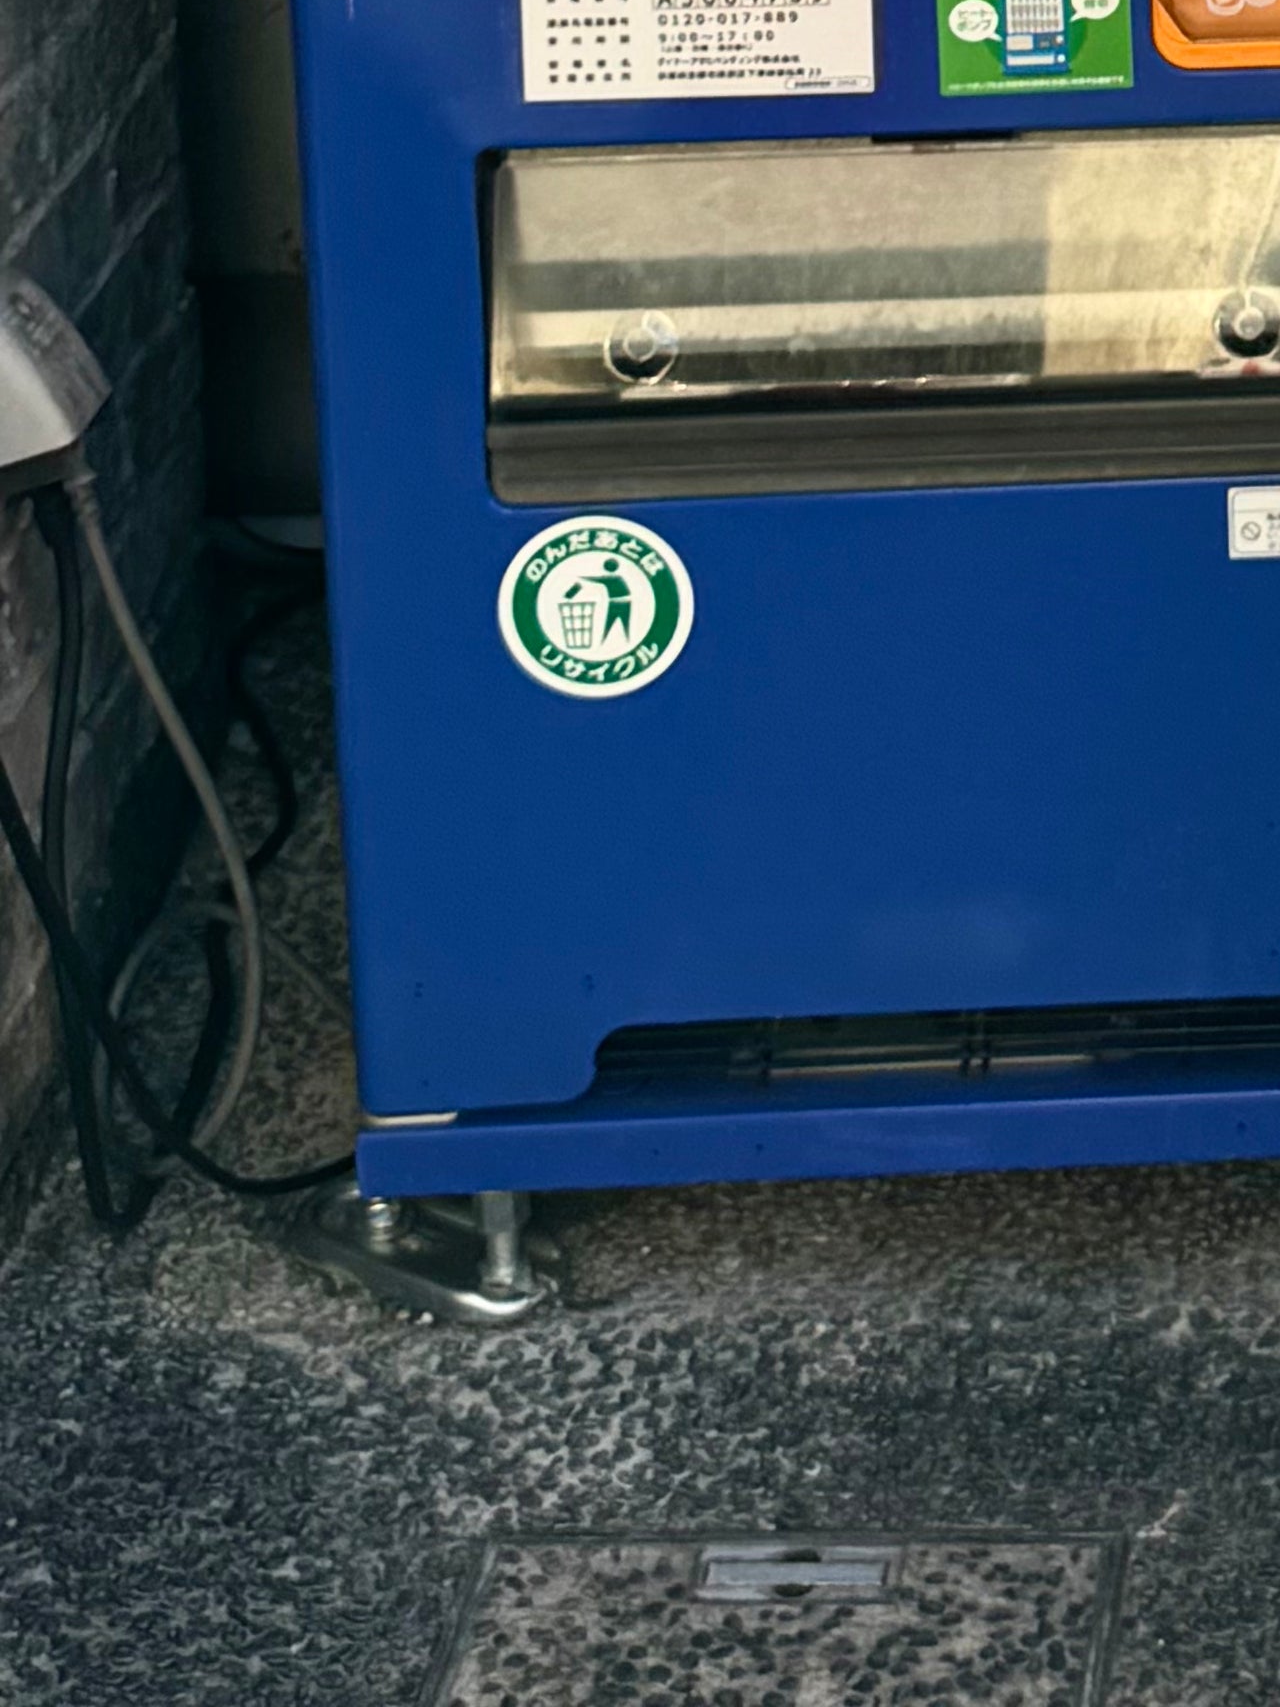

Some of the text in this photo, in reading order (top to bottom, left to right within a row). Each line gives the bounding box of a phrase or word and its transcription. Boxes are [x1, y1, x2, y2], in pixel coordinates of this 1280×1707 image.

[525, 530, 665, 583] のんだあとは
[540, 642, 660, 681] リサイクル
